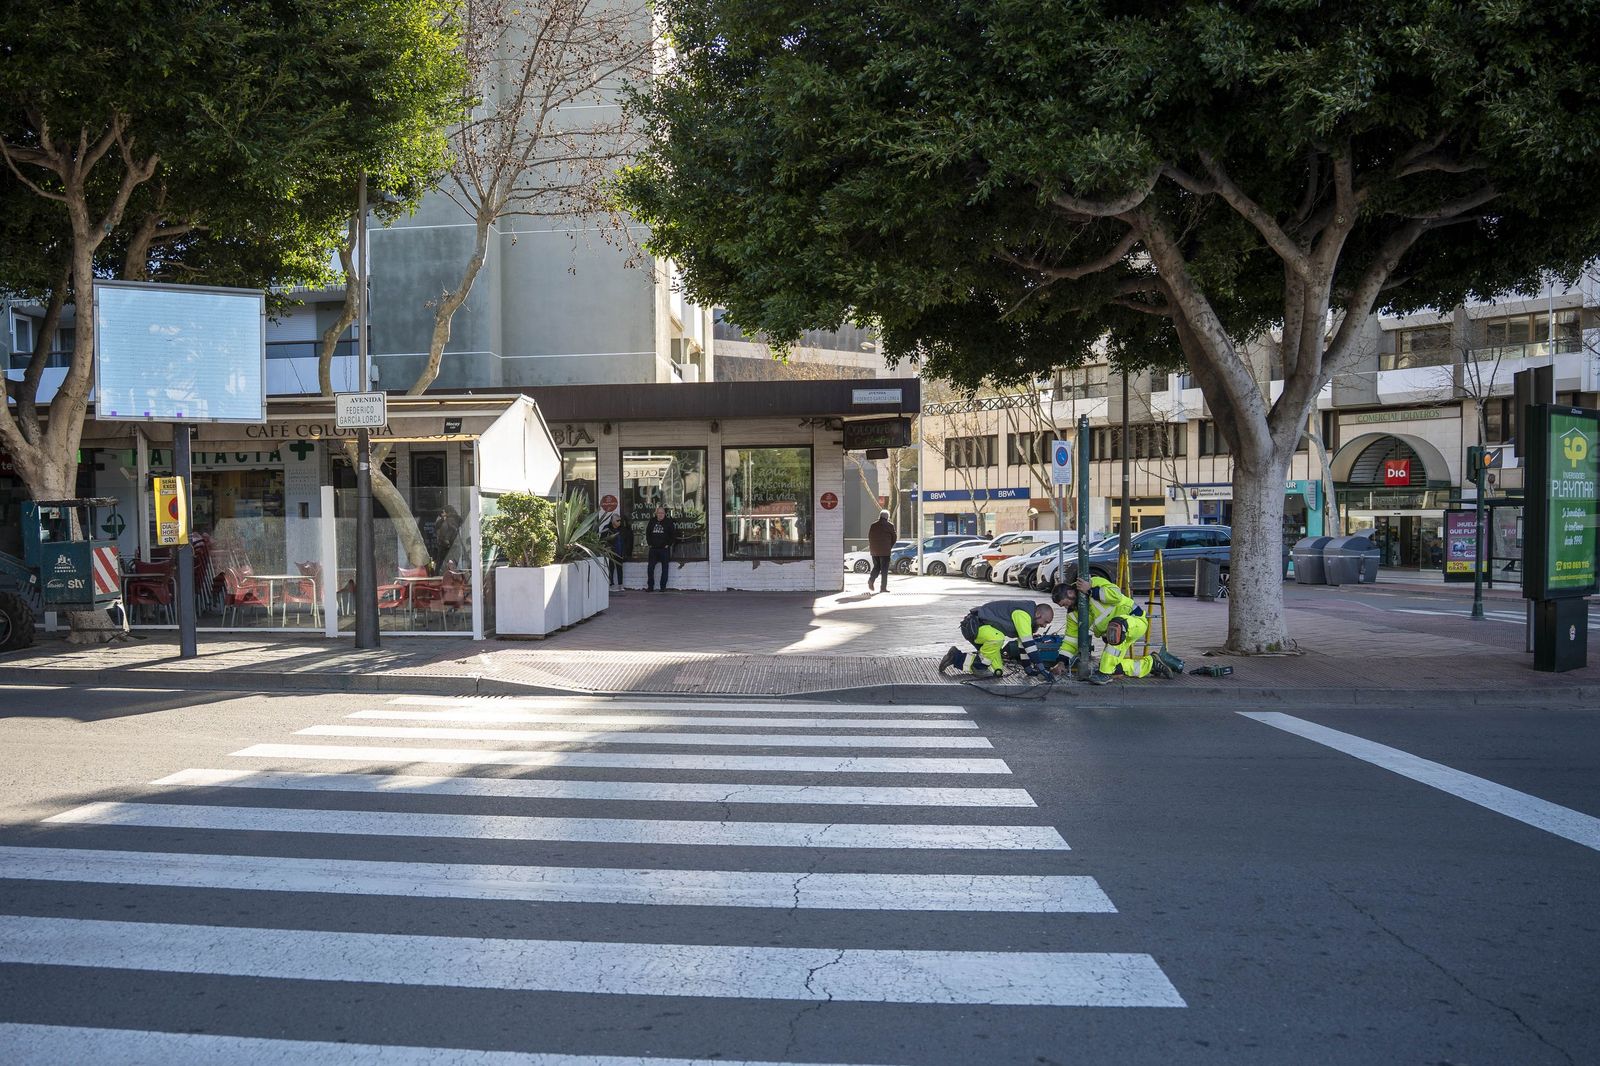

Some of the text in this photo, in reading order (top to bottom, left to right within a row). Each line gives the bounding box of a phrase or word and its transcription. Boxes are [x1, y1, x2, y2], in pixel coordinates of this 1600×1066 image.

[346, 406, 375, 415] FEDERICO
[362, 414, 382, 424] LORCA
[1357, 412, 1398, 423] COMERCIAL
[245, 422, 290, 438] CAFÉ
[998, 490, 1015, 498] BBVA
[1552, 480, 1594, 498] PLAYMAR
[930, 492, 946, 500] BBVA
